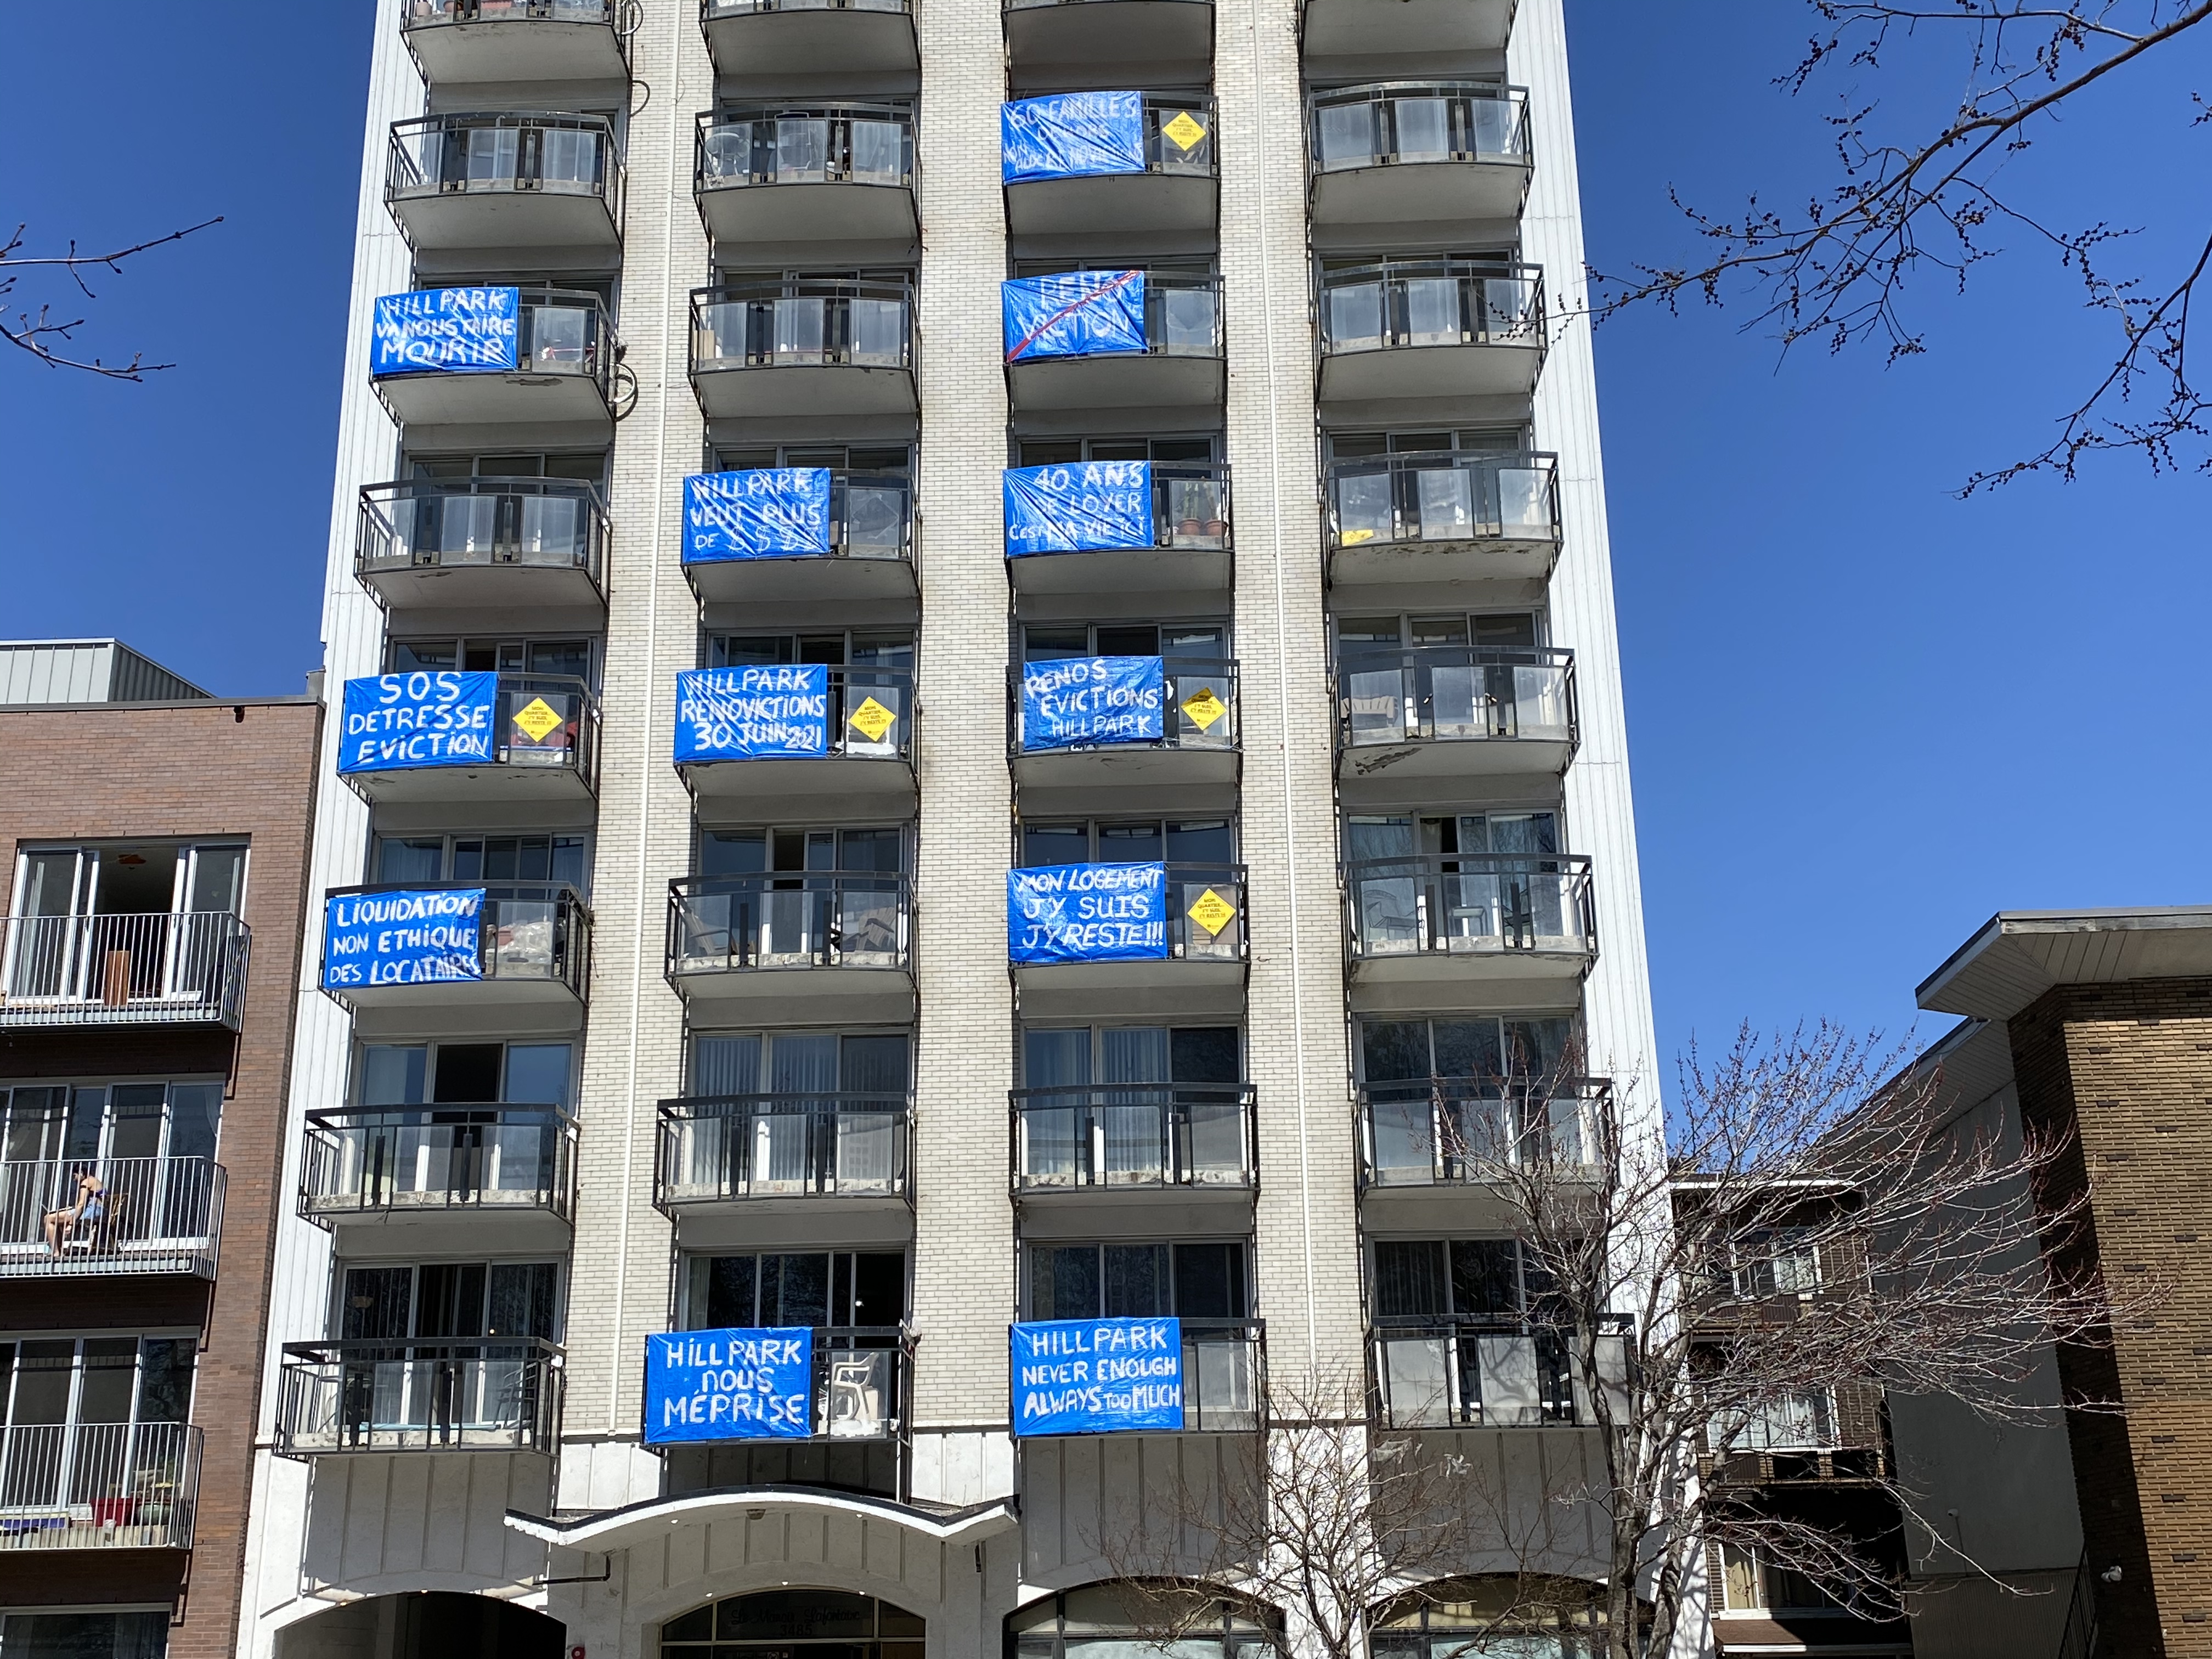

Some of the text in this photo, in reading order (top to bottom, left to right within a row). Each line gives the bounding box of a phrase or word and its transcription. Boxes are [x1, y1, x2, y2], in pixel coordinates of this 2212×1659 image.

[381, 290, 509, 317] HILL PARK
[380, 338, 507, 365] MOURIR
[690, 471, 813, 499] HILL PARK
[1032, 462, 1144, 490] 40 ANS
[689, 503, 822, 527] VEUT PLUS
[1071, 492, 1142, 514] LOYER
[694, 533, 719, 549] DE
[379, 671, 462, 703] SOS
[689, 668, 812, 696] HILL PARK
[1024, 658, 1108, 699] RENOS
[680, 695, 826, 723] RENOVICTIONS
[1040, 685, 1159, 718] EVICTIONS
[693, 722, 732, 751] 30
[738, 721, 789, 744] JUIN
[1052, 715, 1152, 737] HILL PARK
[357, 731, 489, 764] EVICTION
[1017, 867, 1164, 893] MON LOGEMENT
[336, 893, 479, 927] LIQUIDATION
[1077, 894, 1150, 920] SUIS
[332, 923, 477, 957] NON ETHIQUE
[330, 963, 363, 983] DES
[667, 1338, 803, 1369] HILL PARK
[1032, 1325, 1167, 1357] HILL PARK
[1022, 1356, 1177, 1387] NEVER ENOUGH
[664, 1389, 805, 1427] MÉPRISE
[1023, 1385, 1102, 1419] ALWAYS
[1132, 1384, 1180, 1412] MUCH
[780, 1624, 812, 1635] 3485
